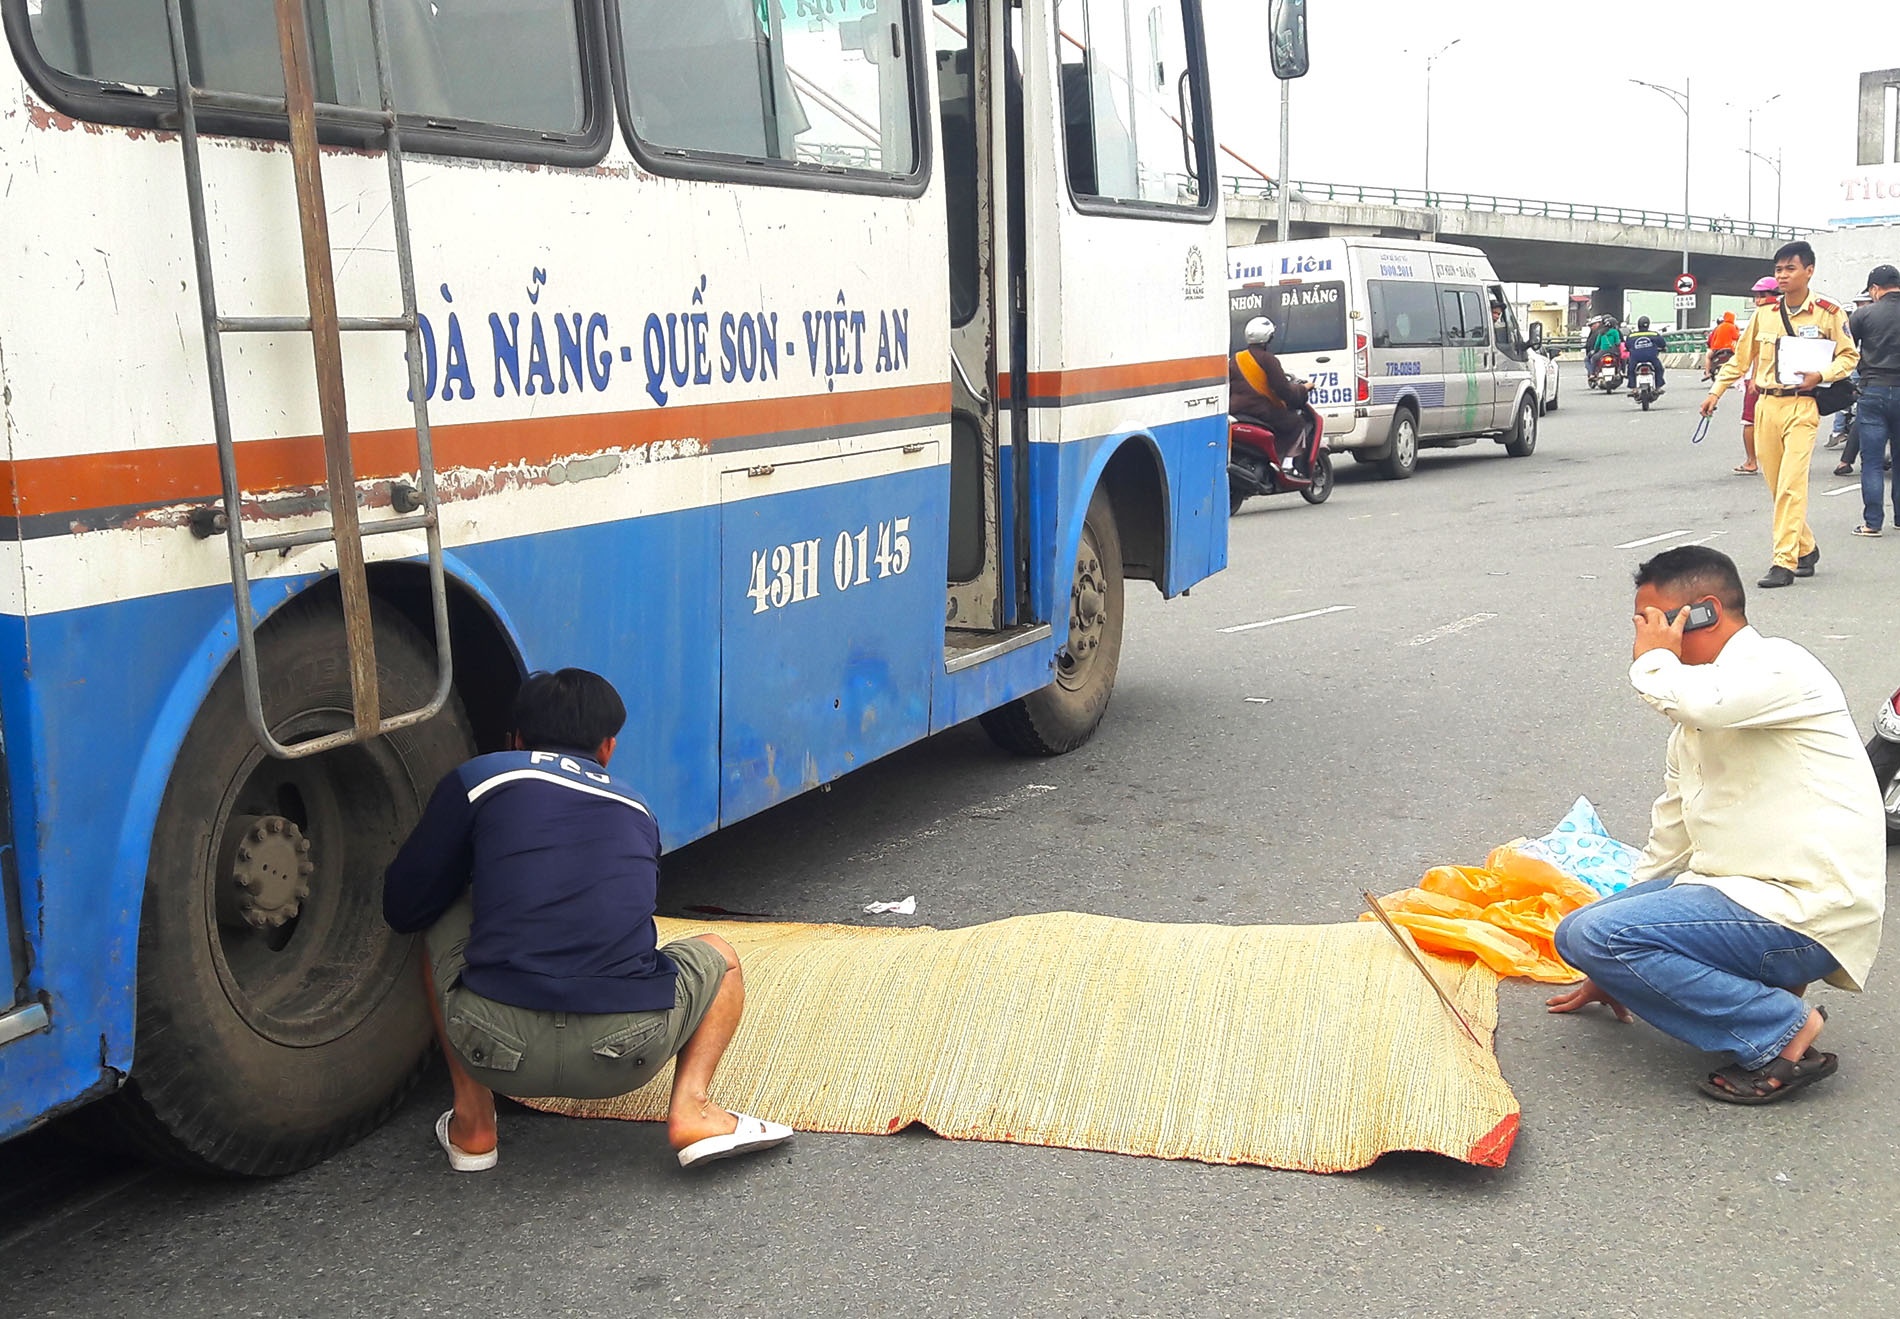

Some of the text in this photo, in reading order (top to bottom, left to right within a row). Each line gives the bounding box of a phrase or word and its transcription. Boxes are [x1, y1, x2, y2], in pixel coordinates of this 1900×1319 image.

[1227, 255, 1332, 279] im Liên
[643, 273, 712, 407] QUẾ
[802, 288, 866, 393] VIỆT
[875, 308, 908, 373] AN
[1309, 372, 1339, 387] 77B
[1309, 387, 1352, 404] 09.08
[746, 516, 911, 614] 43H 0145
